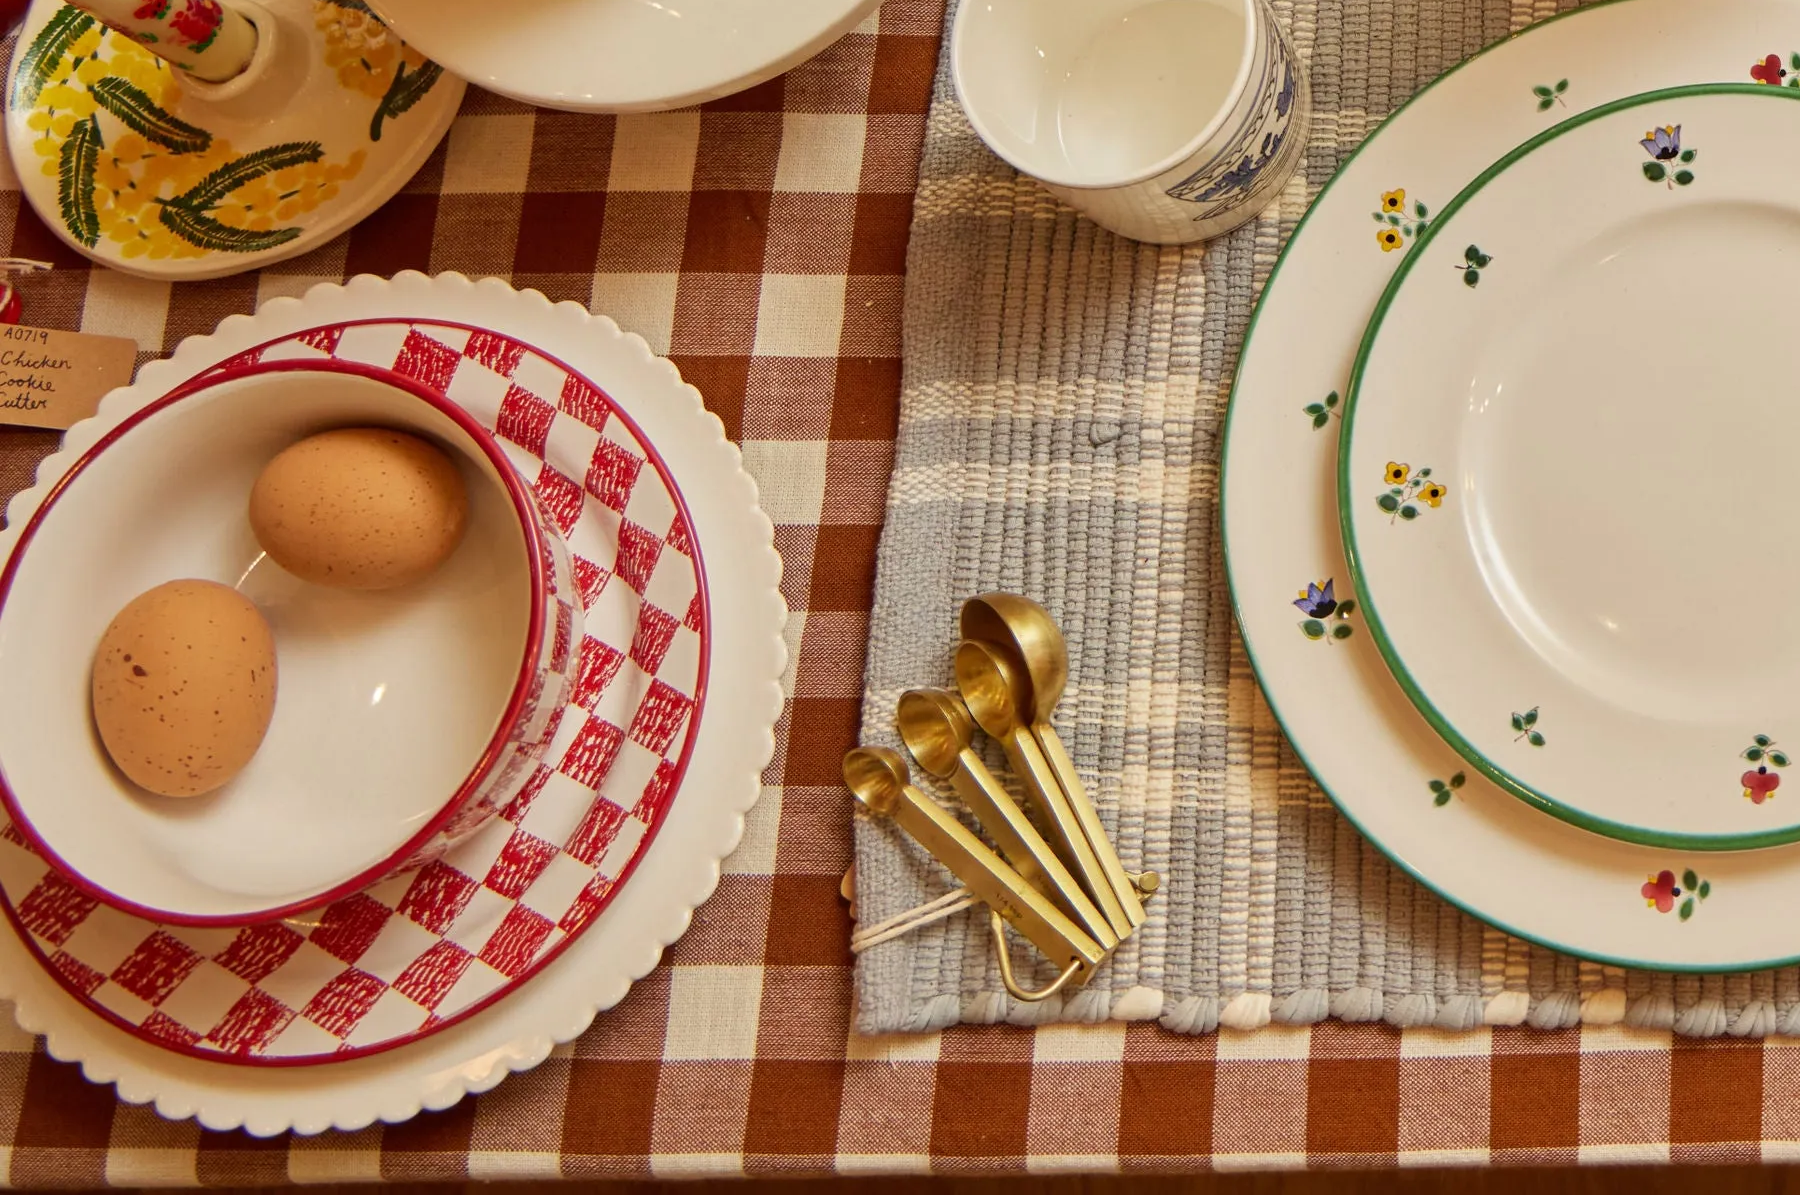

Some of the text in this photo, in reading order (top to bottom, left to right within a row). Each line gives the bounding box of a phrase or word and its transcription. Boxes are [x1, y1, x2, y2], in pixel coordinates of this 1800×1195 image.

[4, 326, 49, 345] A0719
[0, 350, 72, 370] Chicken
[0, 371, 56, 392] Cookie
[0, 391, 48, 410] Cutter
